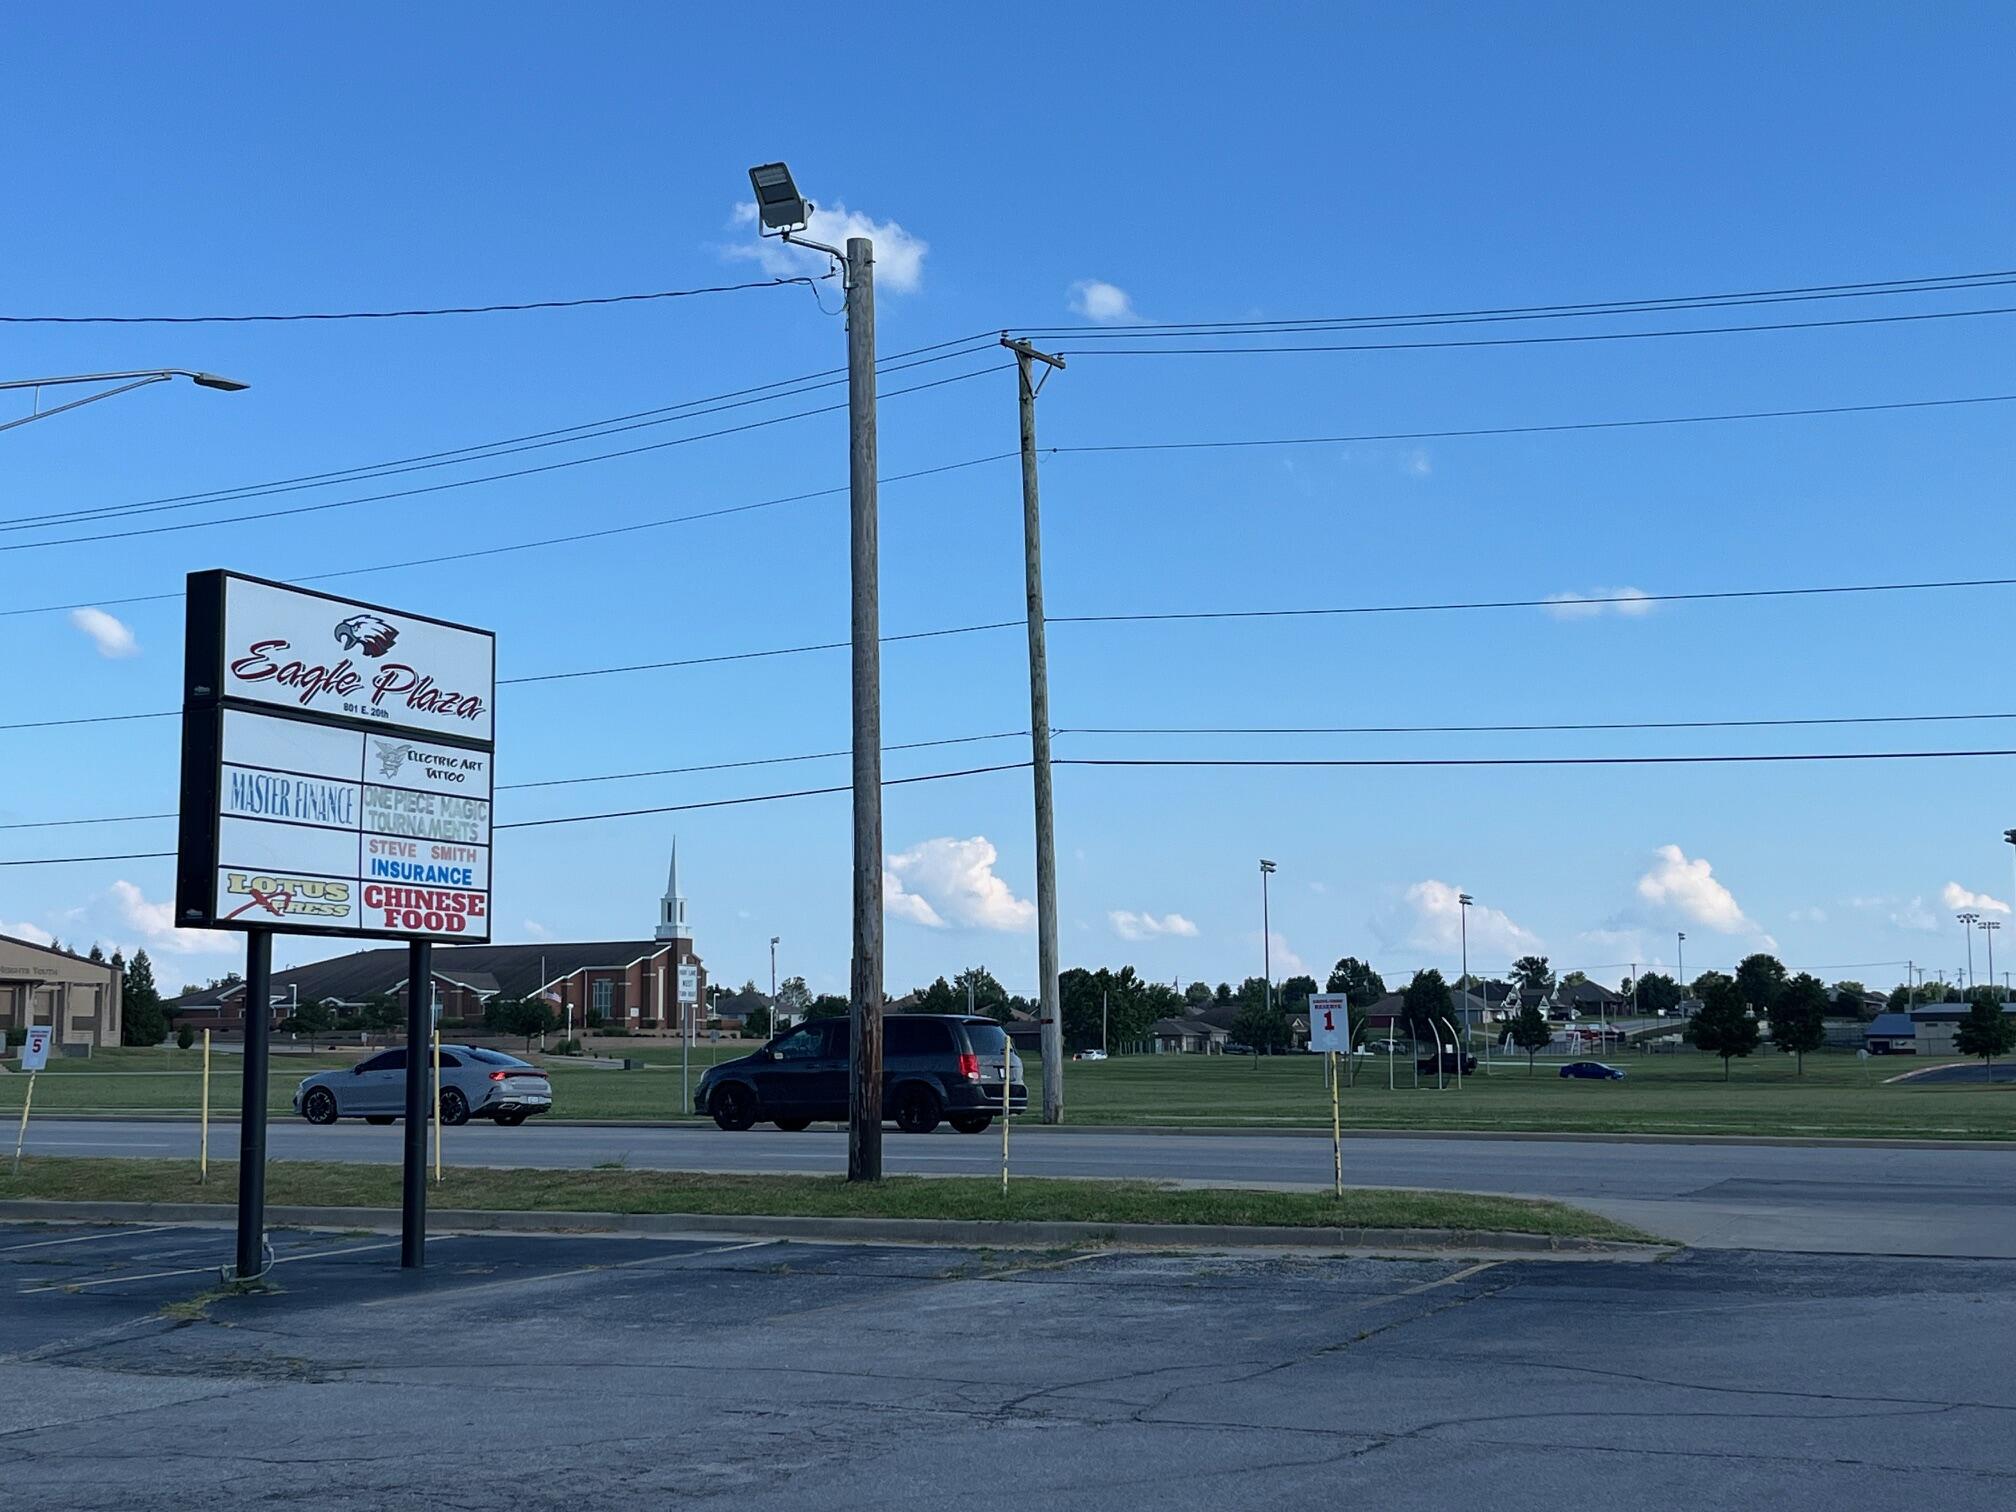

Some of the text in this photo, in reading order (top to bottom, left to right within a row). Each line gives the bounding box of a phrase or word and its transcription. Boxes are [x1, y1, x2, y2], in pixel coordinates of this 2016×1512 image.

[231, 640, 486, 720] Eagle Plaza
[343, 702, 389, 719] 801 E. 20th
[408, 750, 484, 771] ELECTRIC ART
[425, 767, 465, 783] TATTOO
[231, 772, 353, 825] MASTER FINANCE
[364, 786, 487, 822] ONE PIECE MAGIC
[368, 809, 479, 842] TOURNAMENTS
[369, 838, 477, 863] STEVE SMITH
[371, 857, 472, 886] INSURANCE
[227, 873, 350, 902] LOTUS
[364, 884, 485, 917] CHINESE
[384, 908, 466, 933] FOOD
[1324, 1010, 1335, 1030] 1
[32, 1039, 42, 1053] 5
